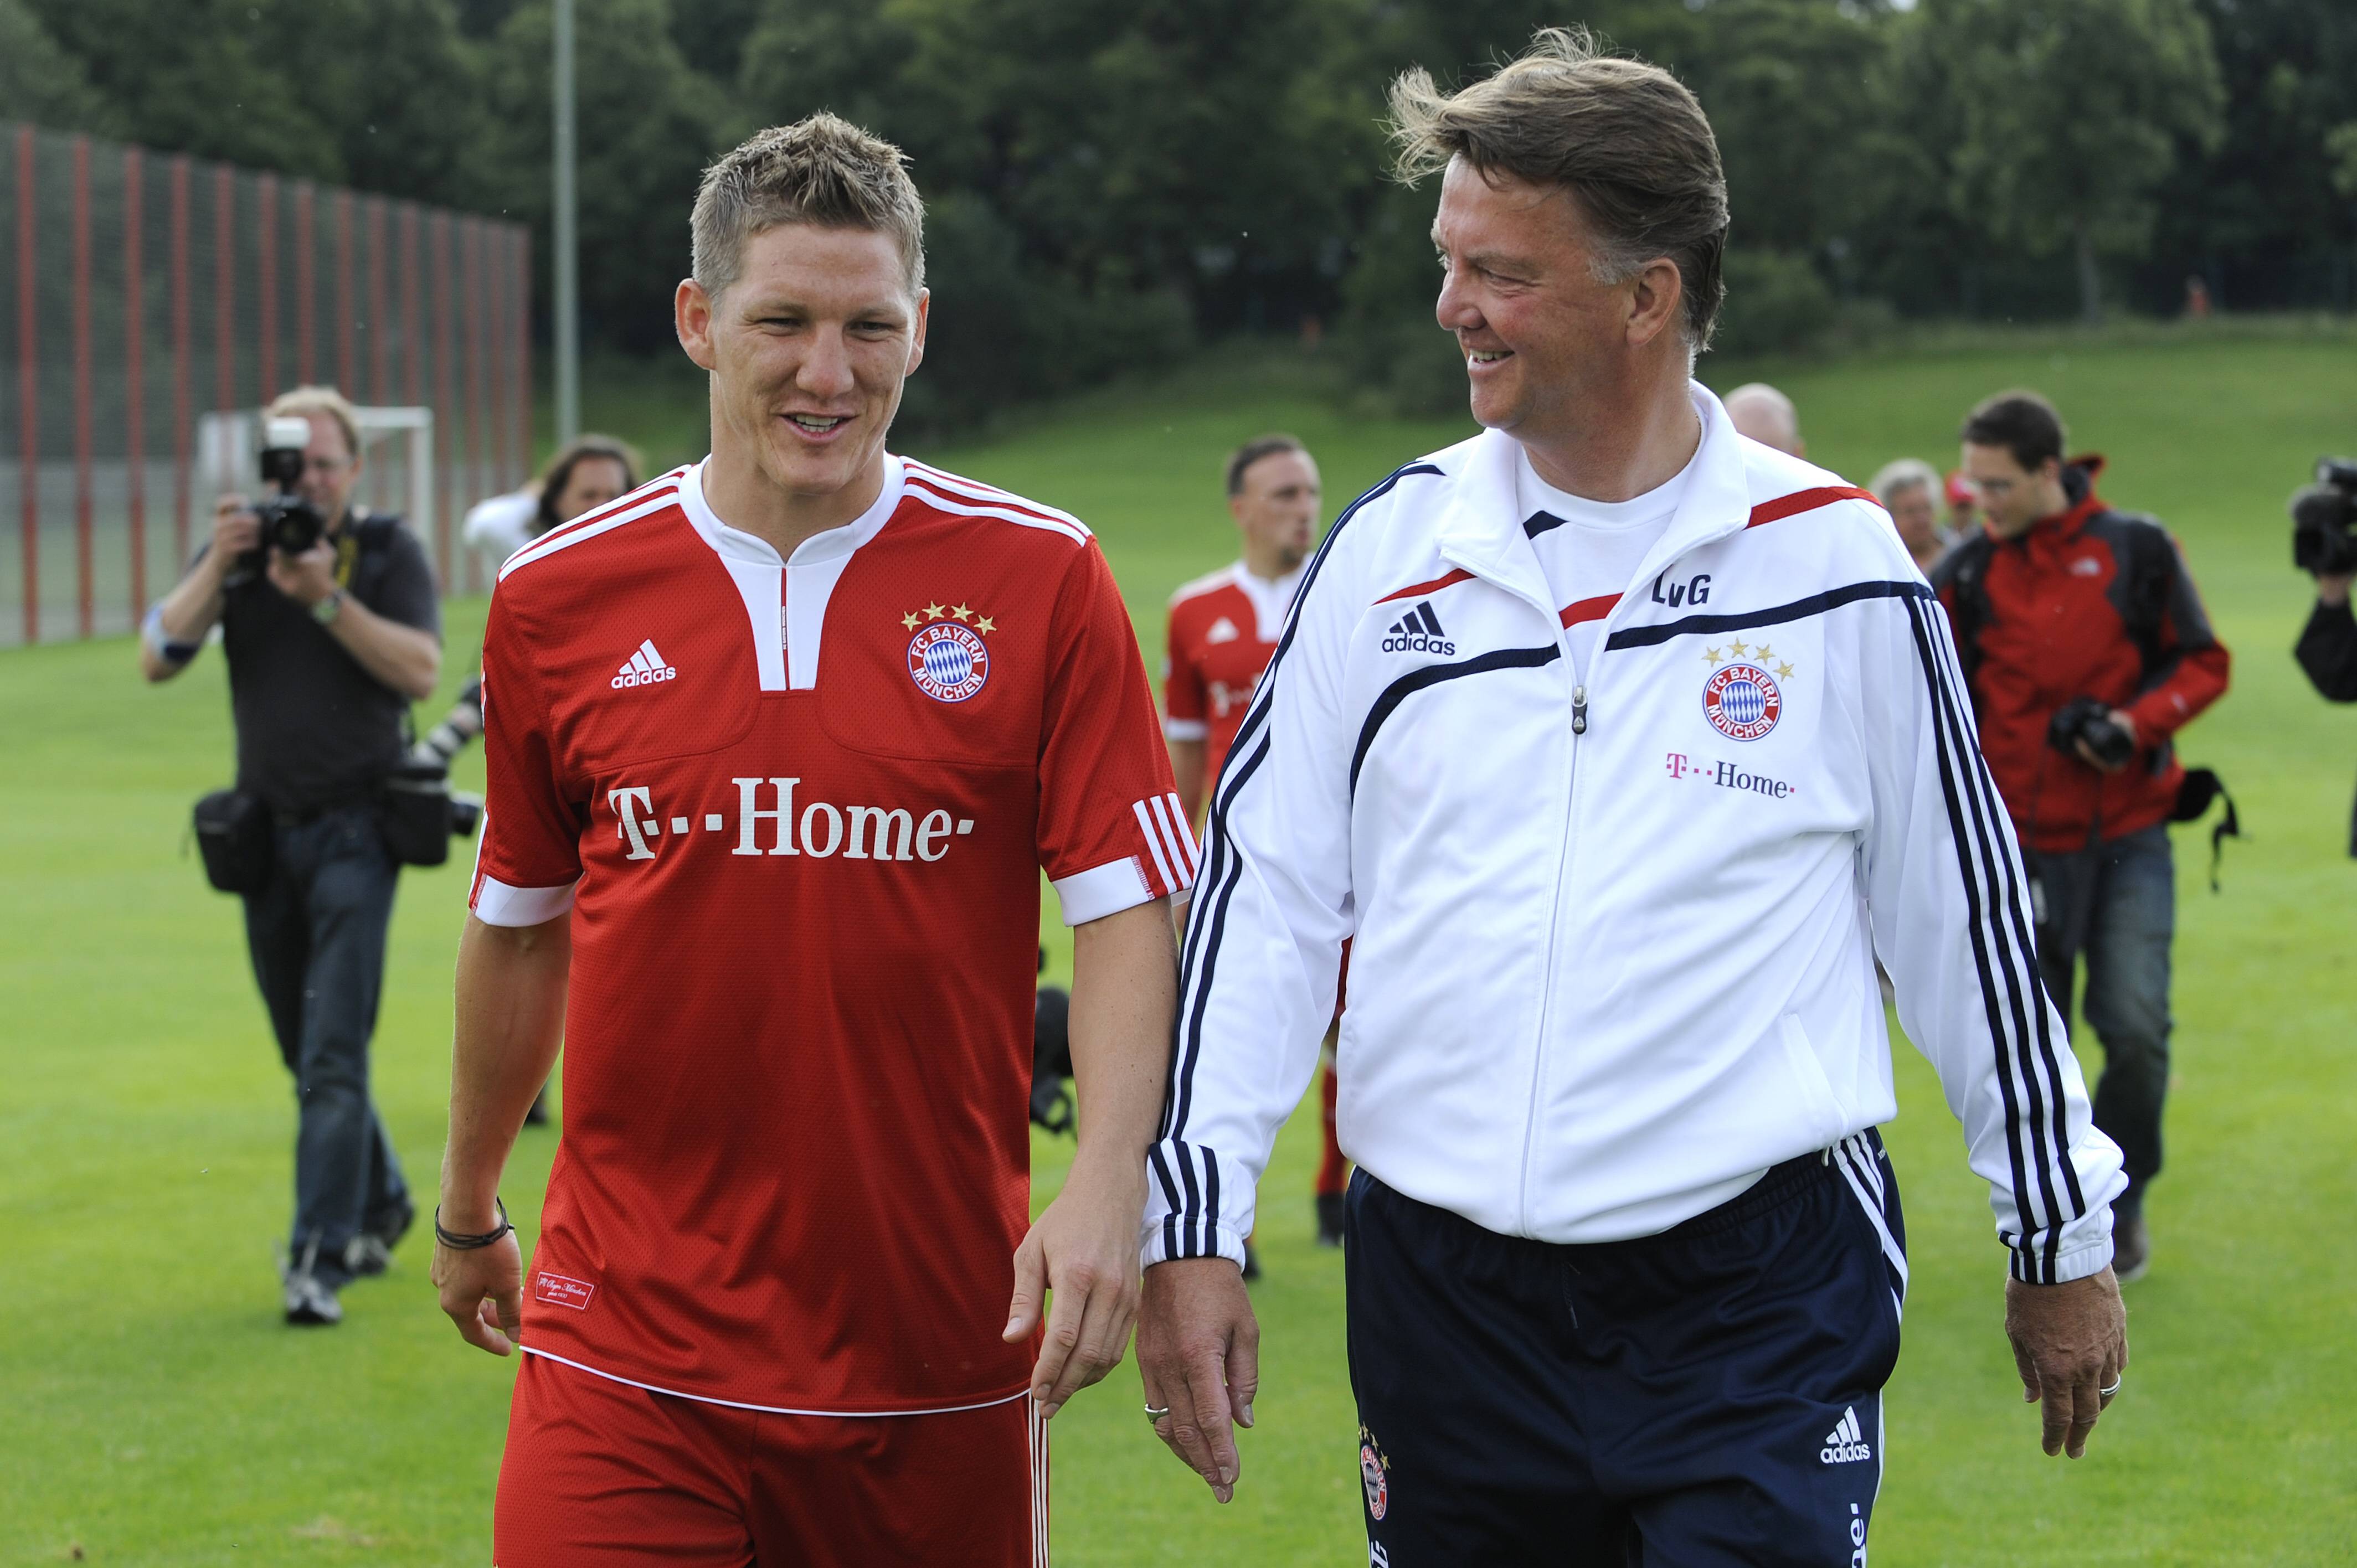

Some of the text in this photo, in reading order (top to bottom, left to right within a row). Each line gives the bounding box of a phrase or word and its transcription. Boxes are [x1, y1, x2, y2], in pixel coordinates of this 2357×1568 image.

[1652, 569, 1711, 608] LvG
[912, 626, 985, 663] FC BAYERN
[1382, 632, 1455, 656] adidas
[611, 667, 676, 689] adidas
[913, 667, 982, 699] MÜNCHEN
[1709, 668, 1778, 706] FC BAYERN
[1707, 704, 1773, 737] MÜNCHEN
[1820, 1441, 1870, 1463] adidas
